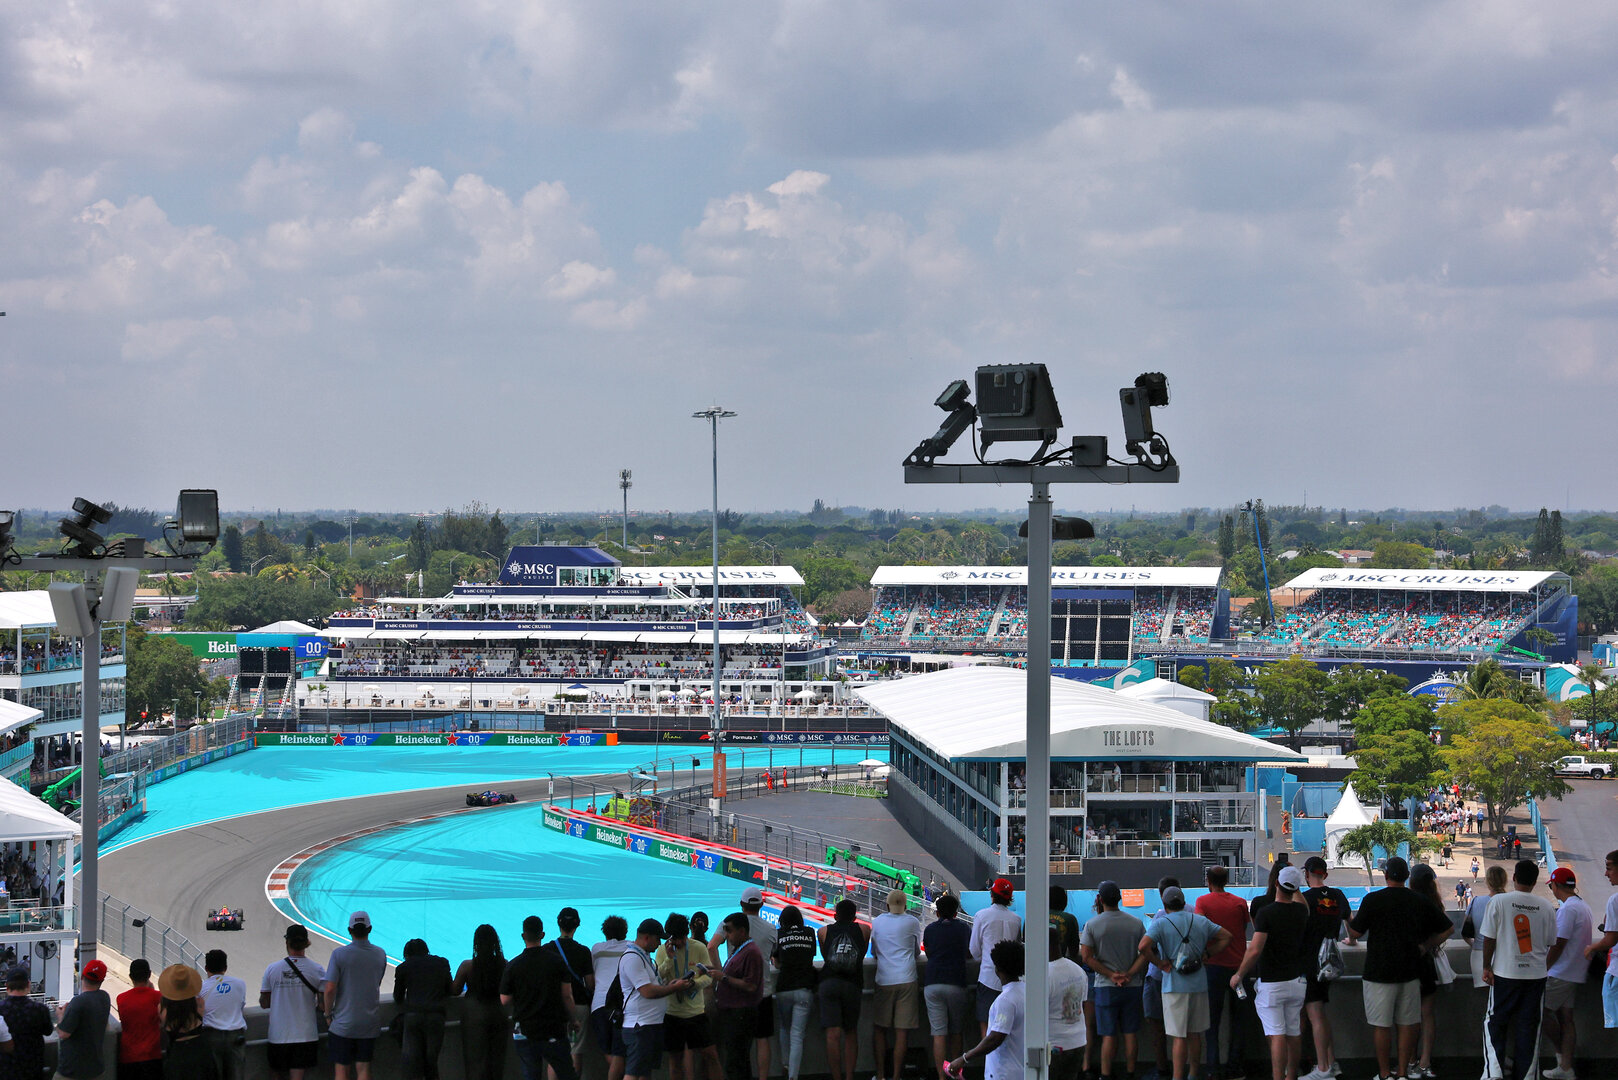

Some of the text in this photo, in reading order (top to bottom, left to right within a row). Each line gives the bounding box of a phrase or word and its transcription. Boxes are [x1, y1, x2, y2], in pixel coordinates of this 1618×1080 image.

[523, 563, 554, 575] MSC
[621, 571, 776, 580] SC CRUISES
[967, 571, 1152, 580] MSC RUISES
[1341, 574, 1520, 585] MSC CRUISES
[305, 641, 321, 654] 0.0
[279, 735, 328, 744] Heineken
[395, 735, 442, 744] Heineken
[507, 735, 553, 744] Heineken
[1103, 730, 1155, 746] THE LOFTS
[544, 812, 563, 830] Heineken
[596, 827, 623, 846] Heineken
[659, 843, 689, 863] Heineken
[778, 935, 813, 944] PETRONAS
[836, 943, 852, 954] EF
[218, 983, 230, 994] hp
